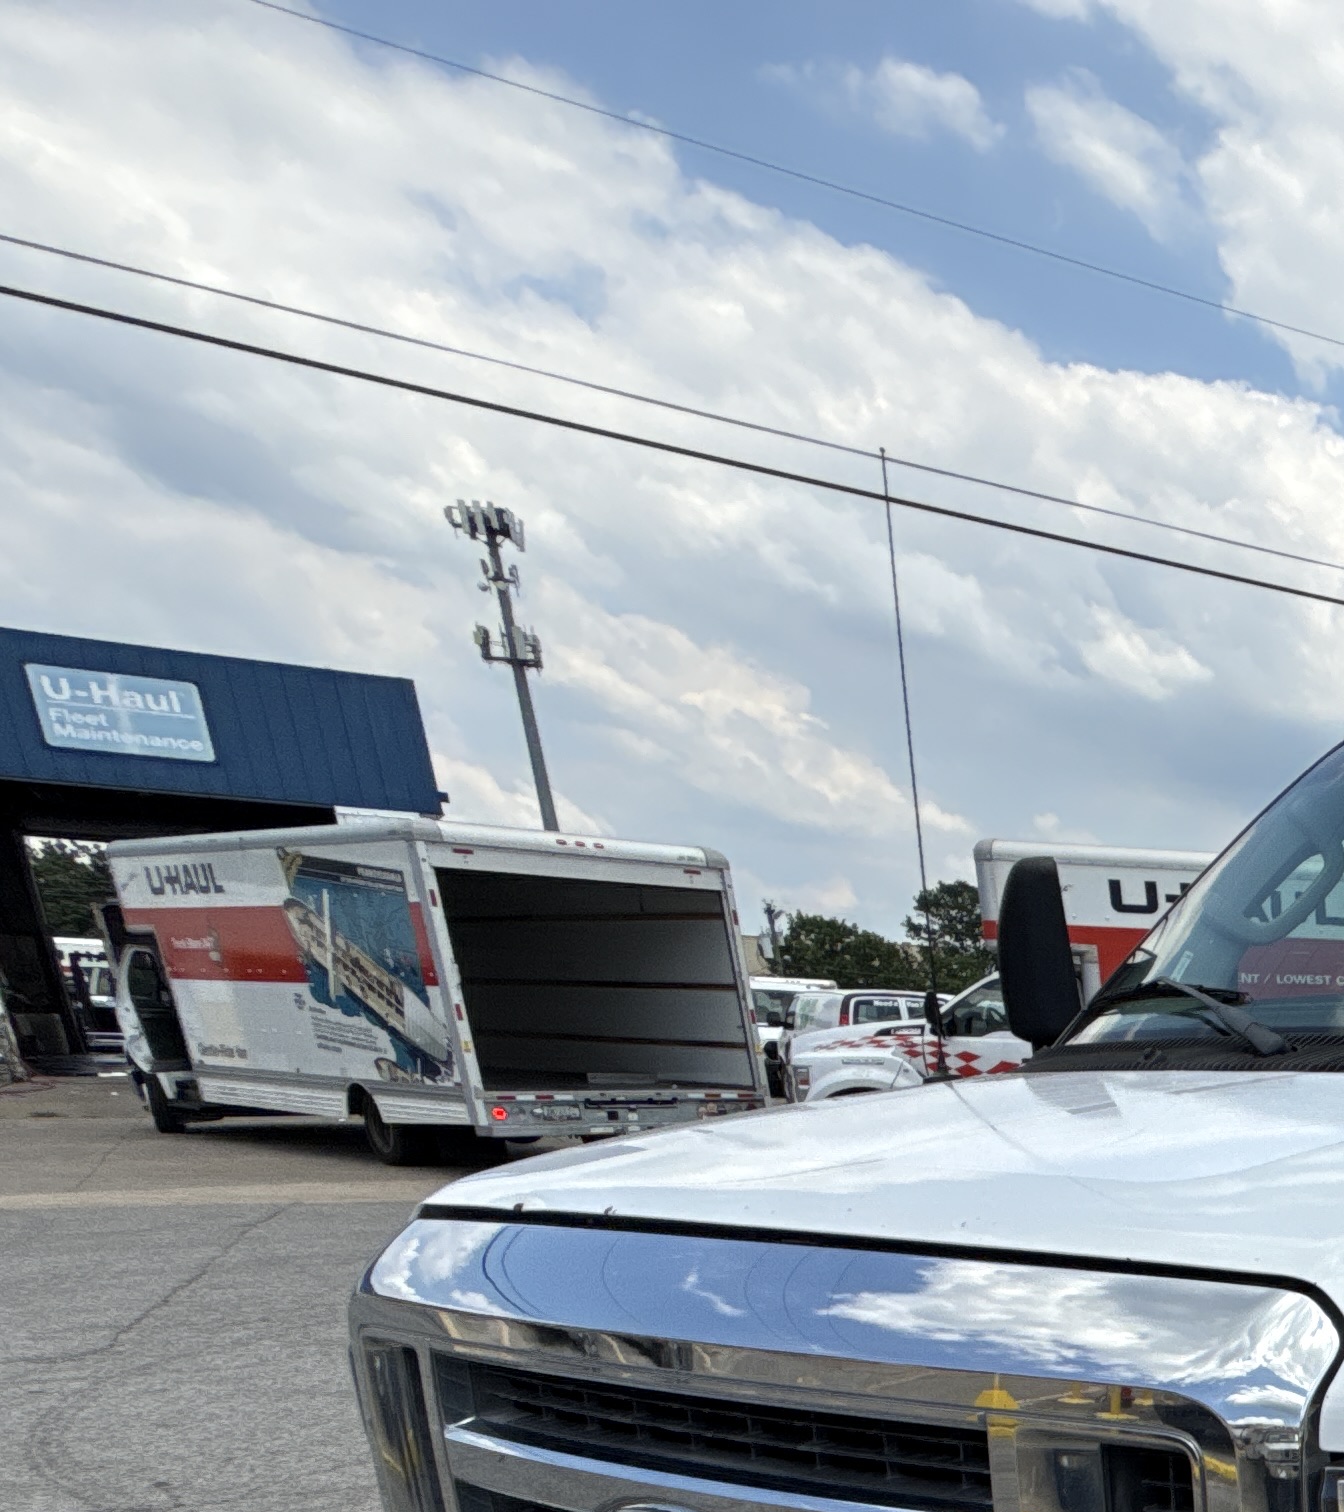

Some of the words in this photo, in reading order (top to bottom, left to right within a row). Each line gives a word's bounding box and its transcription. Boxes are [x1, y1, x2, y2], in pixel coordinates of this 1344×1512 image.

[40, 674, 182, 713] U-Haul
[48, 707, 109, 727] Fleet
[51, 722, 204, 752] Maintenance
[143, 862, 226, 896] U-HAUL
[1275, 973, 1333, 986] LOWEST
